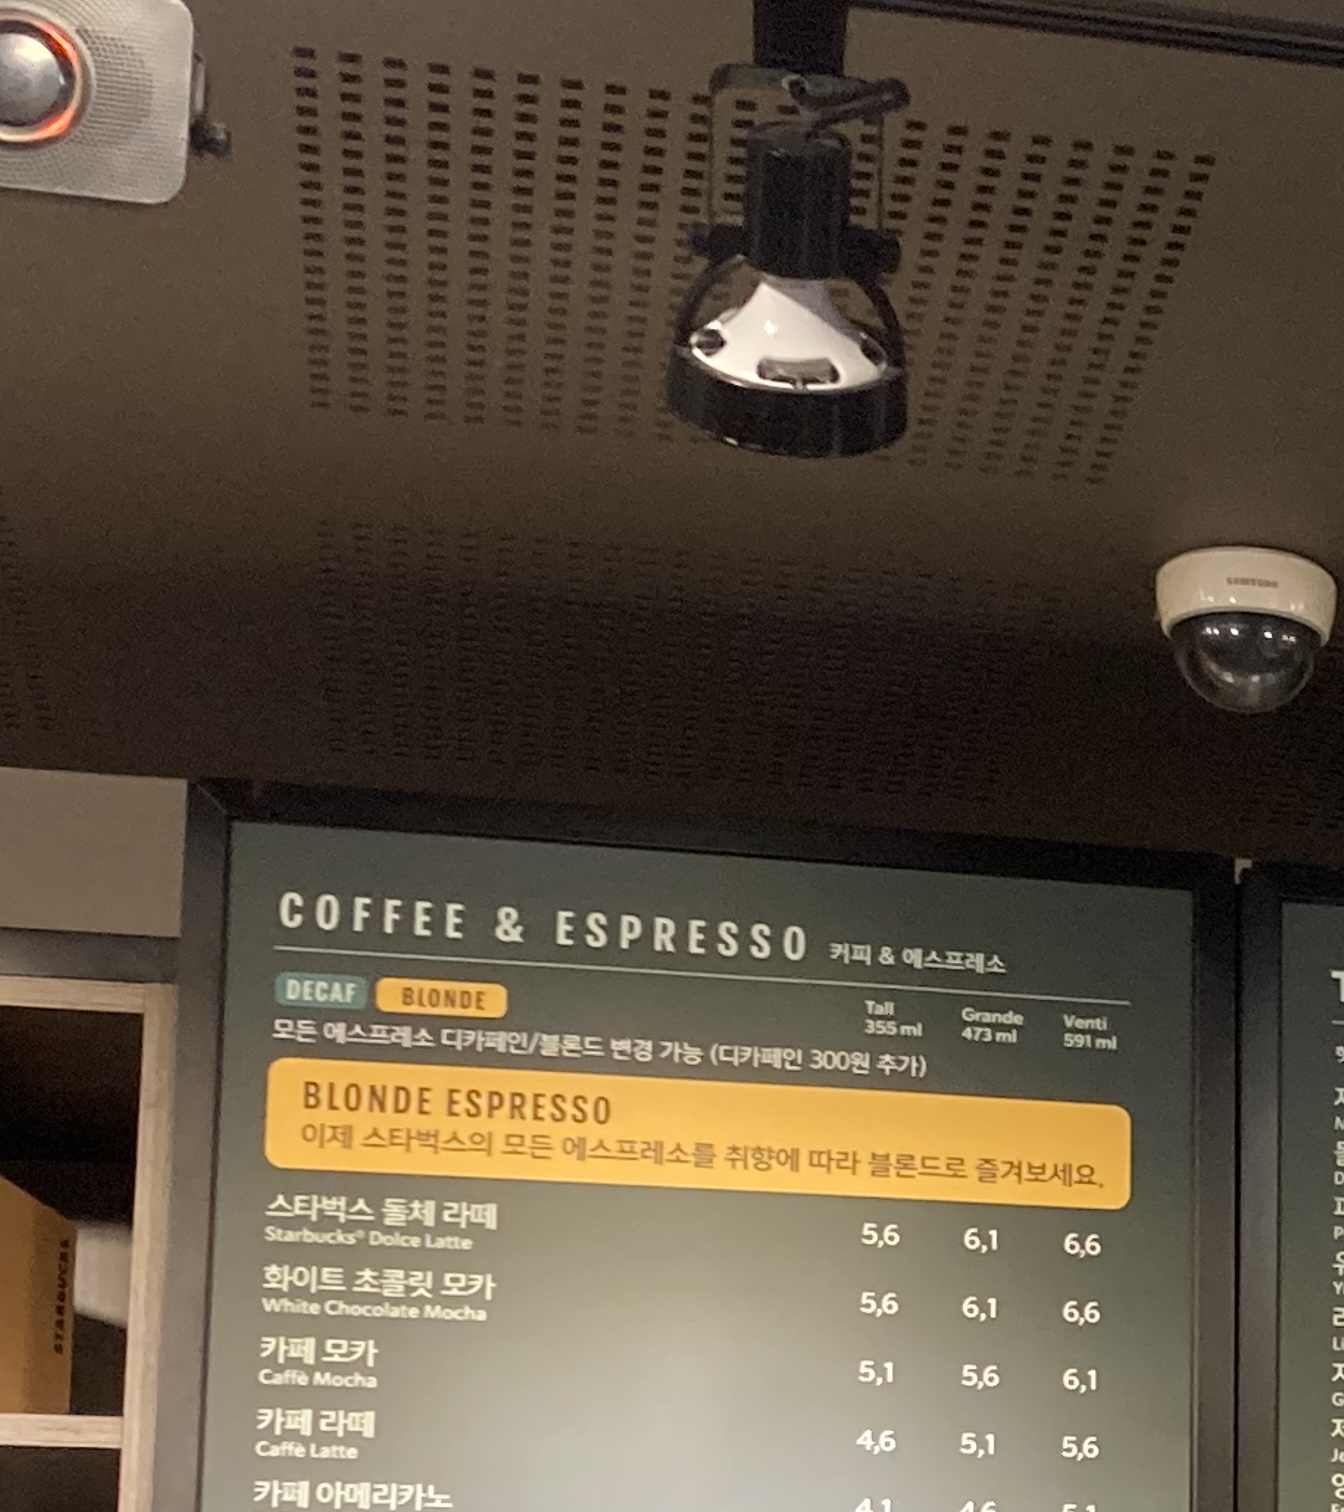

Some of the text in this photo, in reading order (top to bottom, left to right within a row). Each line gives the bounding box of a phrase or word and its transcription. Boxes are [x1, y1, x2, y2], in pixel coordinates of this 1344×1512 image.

[279, 891, 1006, 974] COFFEE & ESPRESSO 커피 & 에스프레소
[285, 978, 486, 1011] DECAF BLONDE
[863, 999, 1108, 1031] Tall Grande Venti
[271, 1017, 927, 1078] 모든 에스프레소 디카페인/블론드 변경 가능 (디카페인 300원 추가)
[302, 1079, 611, 1125] BLONDE ESPRESSO
[300, 1122, 1105, 1189] 이제 스타벅스의 모든 에스프레소를 취향에 따라 블론드로 즐겨보세요.
[264, 1193, 498, 1230] 스타벅스 돌체 라떼
[368, 1229, 422, 1248] Dolce
[424, 1232, 473, 1250] Latte
[252, 1479, 454, 1511] 카페 아메리카노
